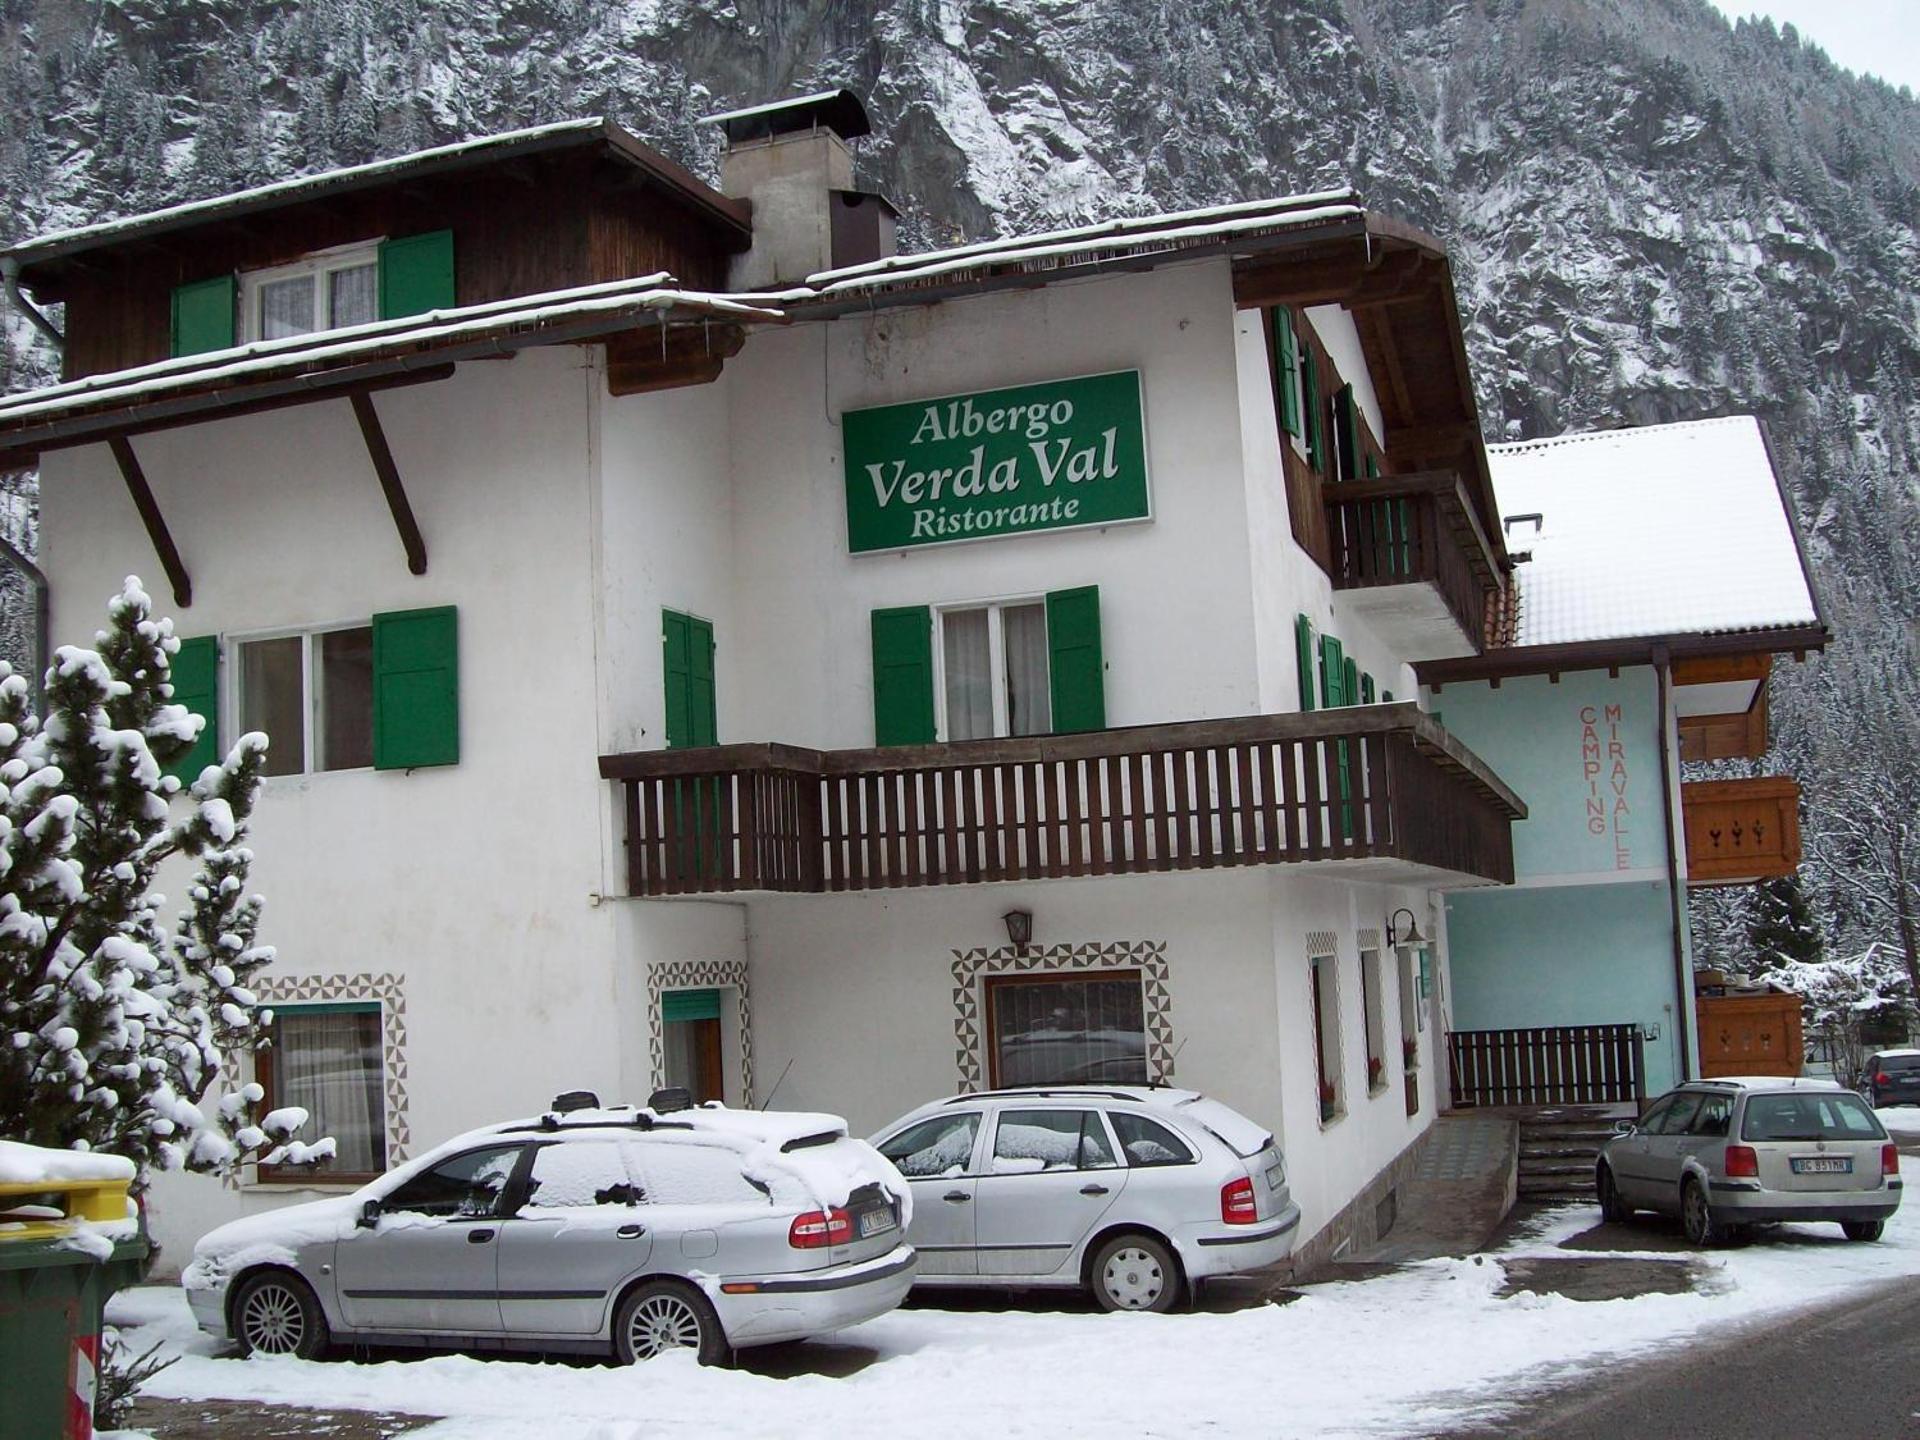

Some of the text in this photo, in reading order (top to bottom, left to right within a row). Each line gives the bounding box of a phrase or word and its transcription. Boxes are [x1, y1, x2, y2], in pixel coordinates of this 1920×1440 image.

[910, 398, 1074, 445] Albergo
[865, 427, 1119, 508] Verda Val
[910, 496, 1080, 538] Ristorante
[1579, 706, 1606, 835] CAMPING
[1604, 703, 1630, 871] MIRAVALLE
